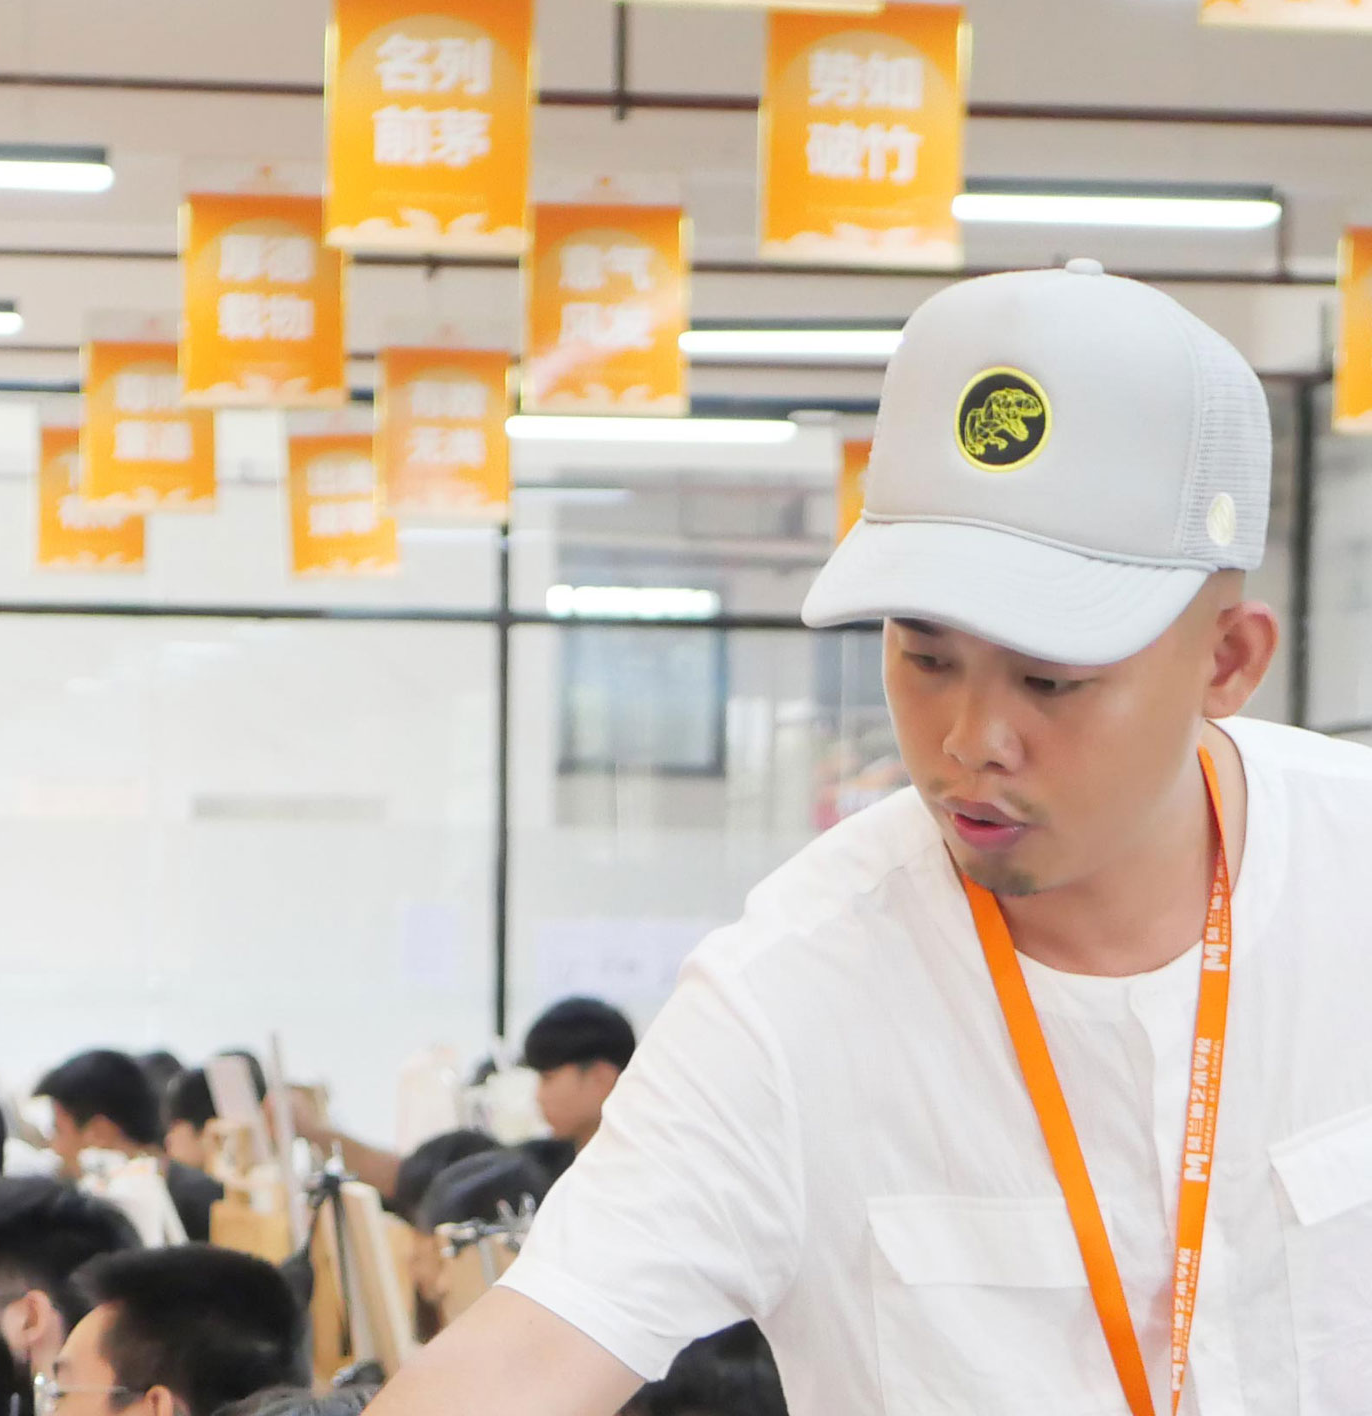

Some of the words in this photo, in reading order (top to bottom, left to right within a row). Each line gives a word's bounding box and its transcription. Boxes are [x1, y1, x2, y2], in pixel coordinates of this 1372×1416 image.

[374, 33, 494, 96] 名列
[807, 49, 924, 111] 势如
[371, 103, 493, 170] 前茅
[805, 120, 925, 186] 破竹
